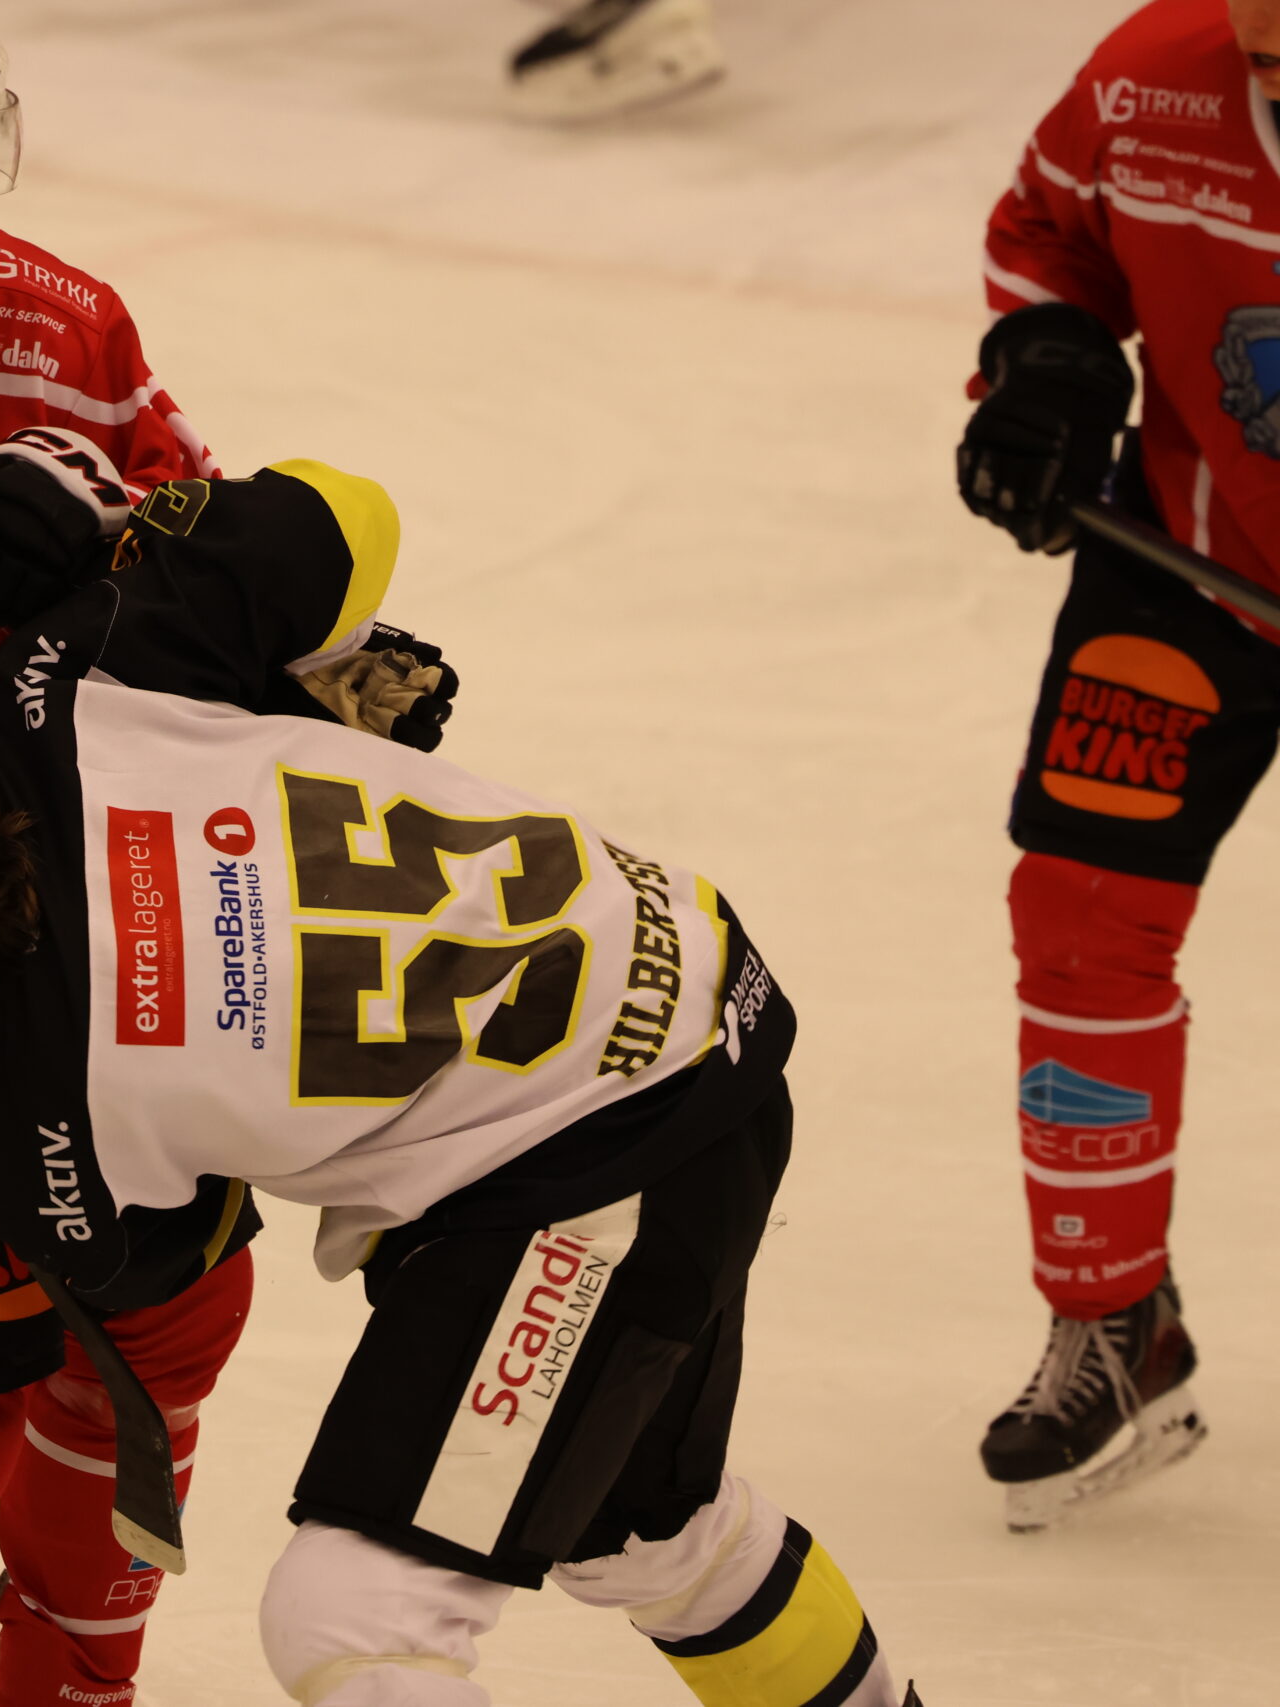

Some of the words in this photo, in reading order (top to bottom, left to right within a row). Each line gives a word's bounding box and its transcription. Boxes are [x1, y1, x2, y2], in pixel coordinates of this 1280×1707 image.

[15, 309, 67, 335] SERVICE
[7, 428, 131, 508] CM
[1044, 715, 1189, 791] KING
[213, 823, 247, 841] 1
[209, 859, 251, 1031] SpareBank
[276, 761, 594, 1108] 55
[740, 966, 772, 1032] SPORT
[37, 1120, 93, 1242] aktiv.
[531, 1255, 609, 1400] LAHOLMEN
